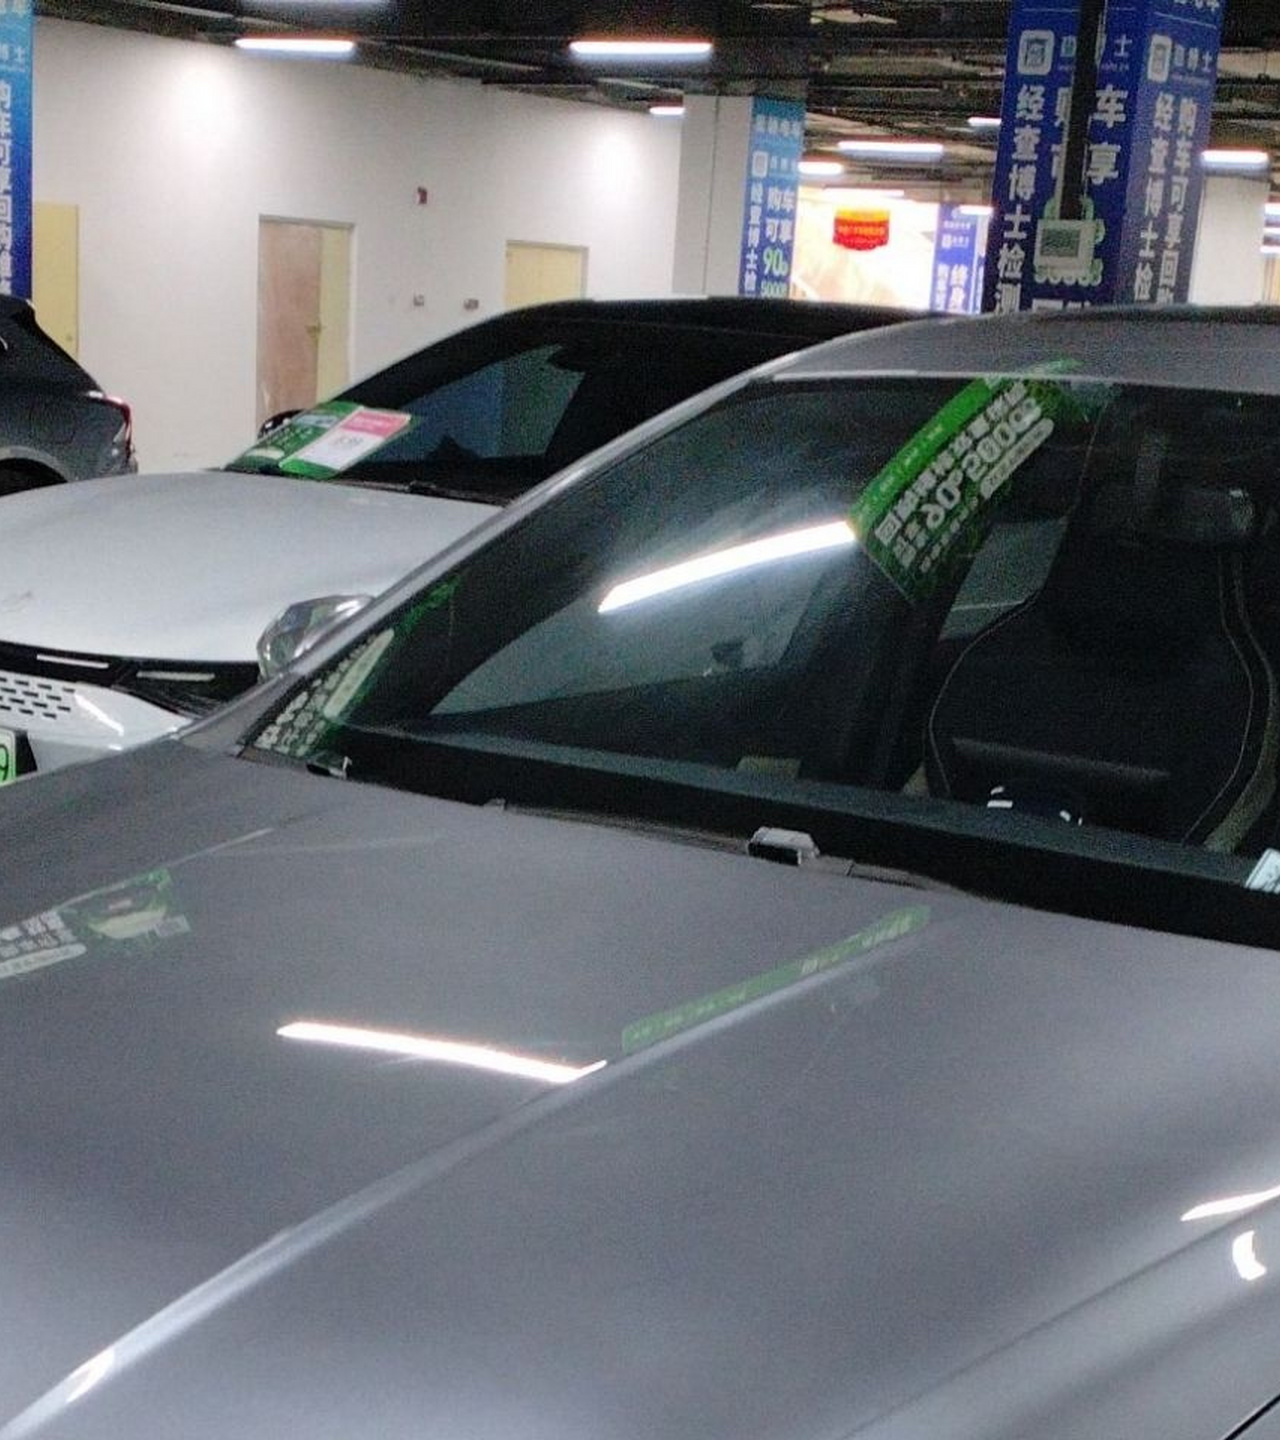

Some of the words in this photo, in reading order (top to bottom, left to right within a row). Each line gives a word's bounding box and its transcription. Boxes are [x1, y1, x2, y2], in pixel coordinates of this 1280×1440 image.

[995, 84, 1046, 314] 经查博士检测
